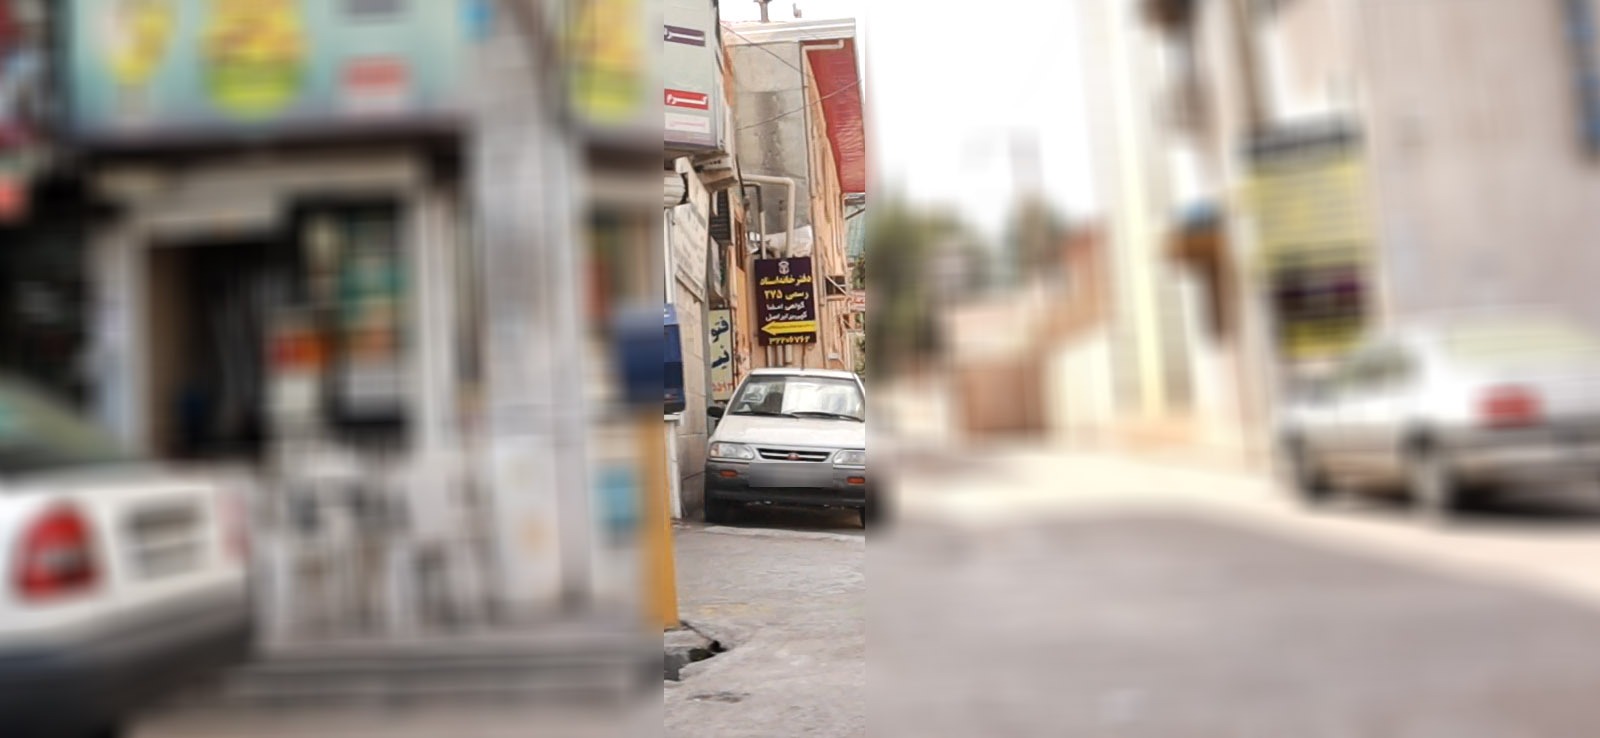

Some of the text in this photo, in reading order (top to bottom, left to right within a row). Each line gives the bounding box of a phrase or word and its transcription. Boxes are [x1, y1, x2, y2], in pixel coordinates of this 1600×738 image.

[796, 273, 812, 286] دفتر
[785, 290, 809, 300] رسمی
[785, 301, 805, 311] گواهی
[711, 316, 729, 343] فتو
